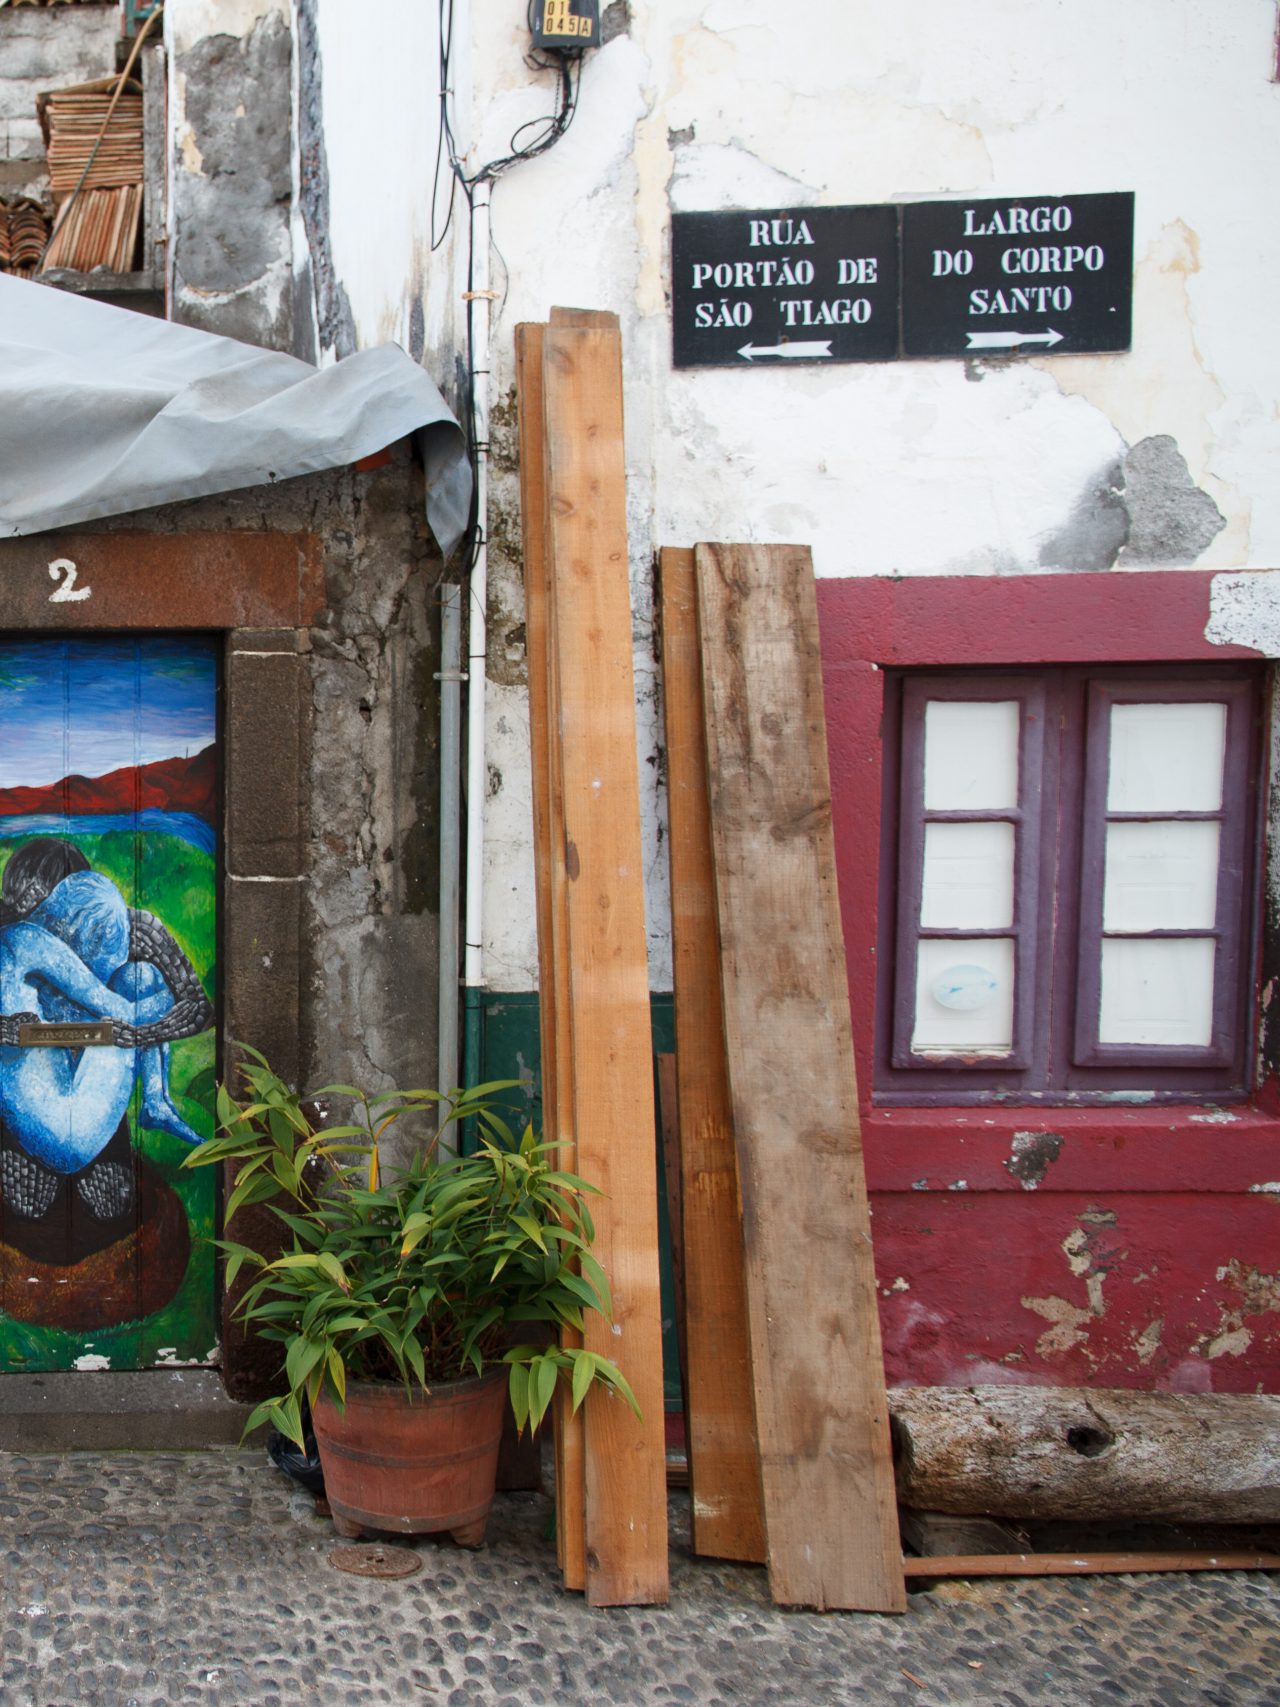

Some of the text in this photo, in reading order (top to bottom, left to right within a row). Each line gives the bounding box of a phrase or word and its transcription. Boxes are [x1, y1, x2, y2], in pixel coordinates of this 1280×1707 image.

[547, 1, 564, 16] 01
[749, 219, 815, 247] RUA
[963, 205, 1073, 237] LARGO
[692, 257, 878, 289] PORTÃO DE
[932, 244, 1104, 277] DO CORPO
[694, 298, 872, 328] SÃO TIAGO
[969, 285, 1073, 315] SANTO
[48, 558, 92, 602] 2
